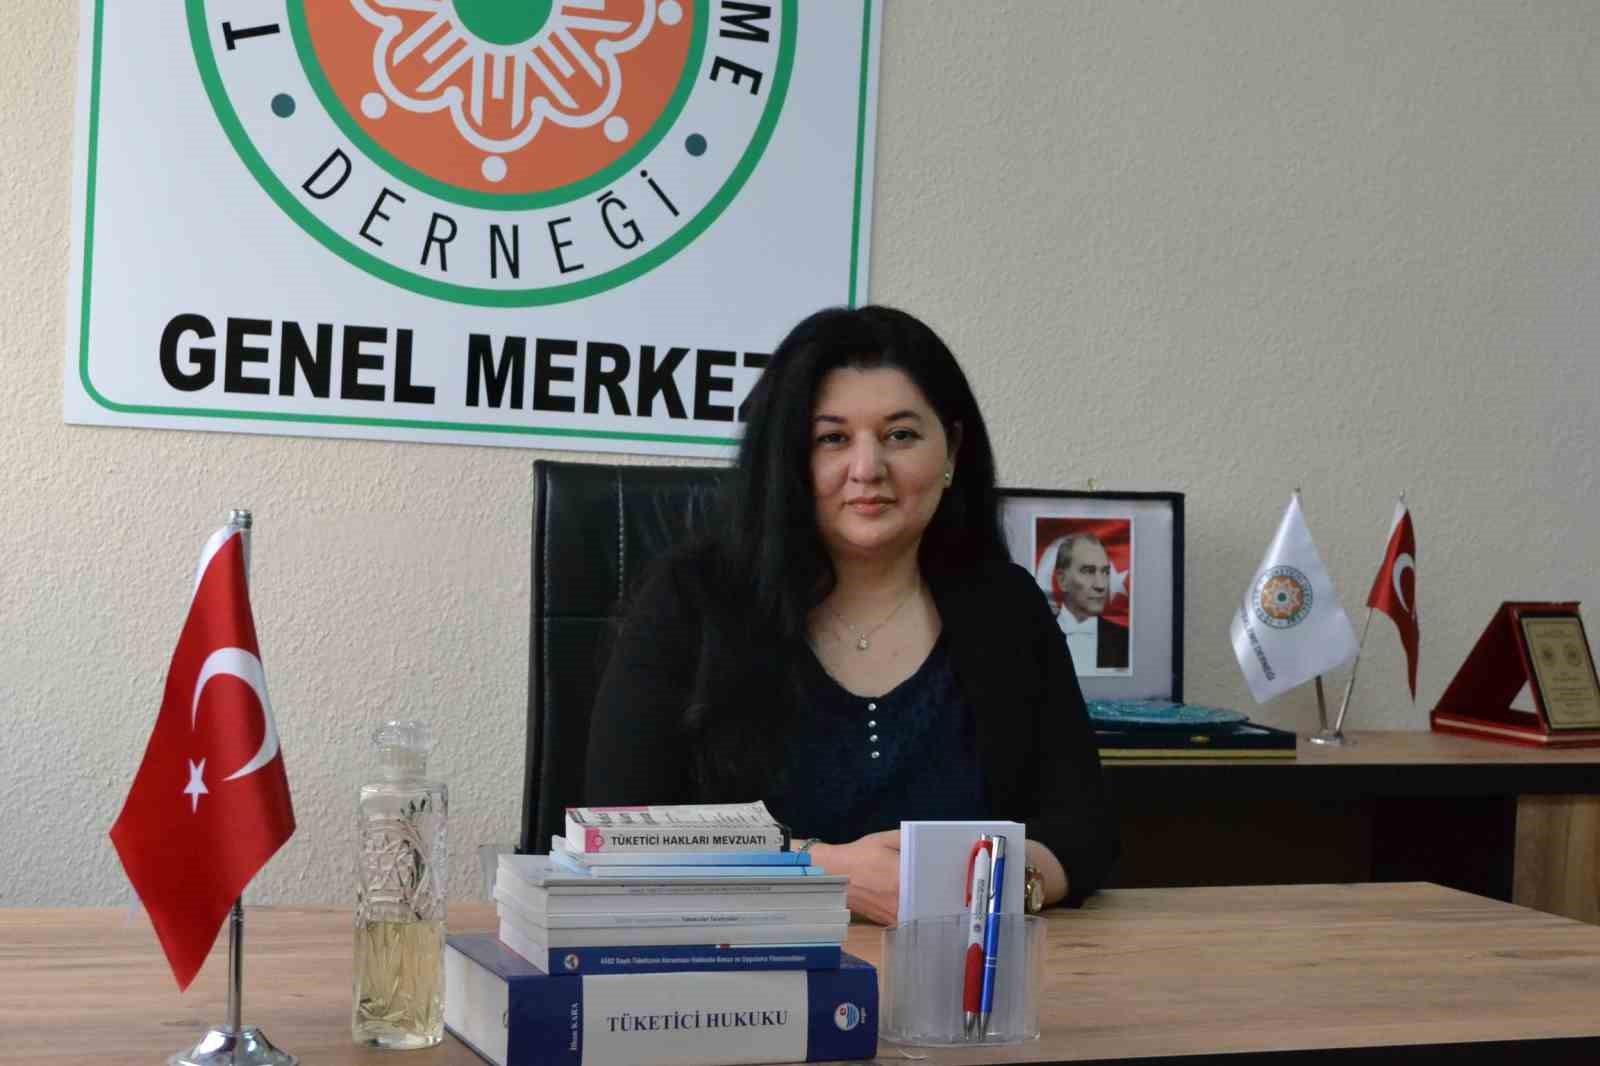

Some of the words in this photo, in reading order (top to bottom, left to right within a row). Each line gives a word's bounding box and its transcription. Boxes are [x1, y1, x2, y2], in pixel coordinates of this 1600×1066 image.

[302, 147, 680, 280] DERNEĞİ
[159, 312, 436, 405] GENEL
[611, 833, 660, 847] TÜKETİCİ
[662, 833, 708, 846] HAKLARI
[712, 833, 767, 846] MEVZUATI
[606, 1010, 700, 1033] TÜKETİCİ
[705, 1010, 789, 1029] HUKUKU
